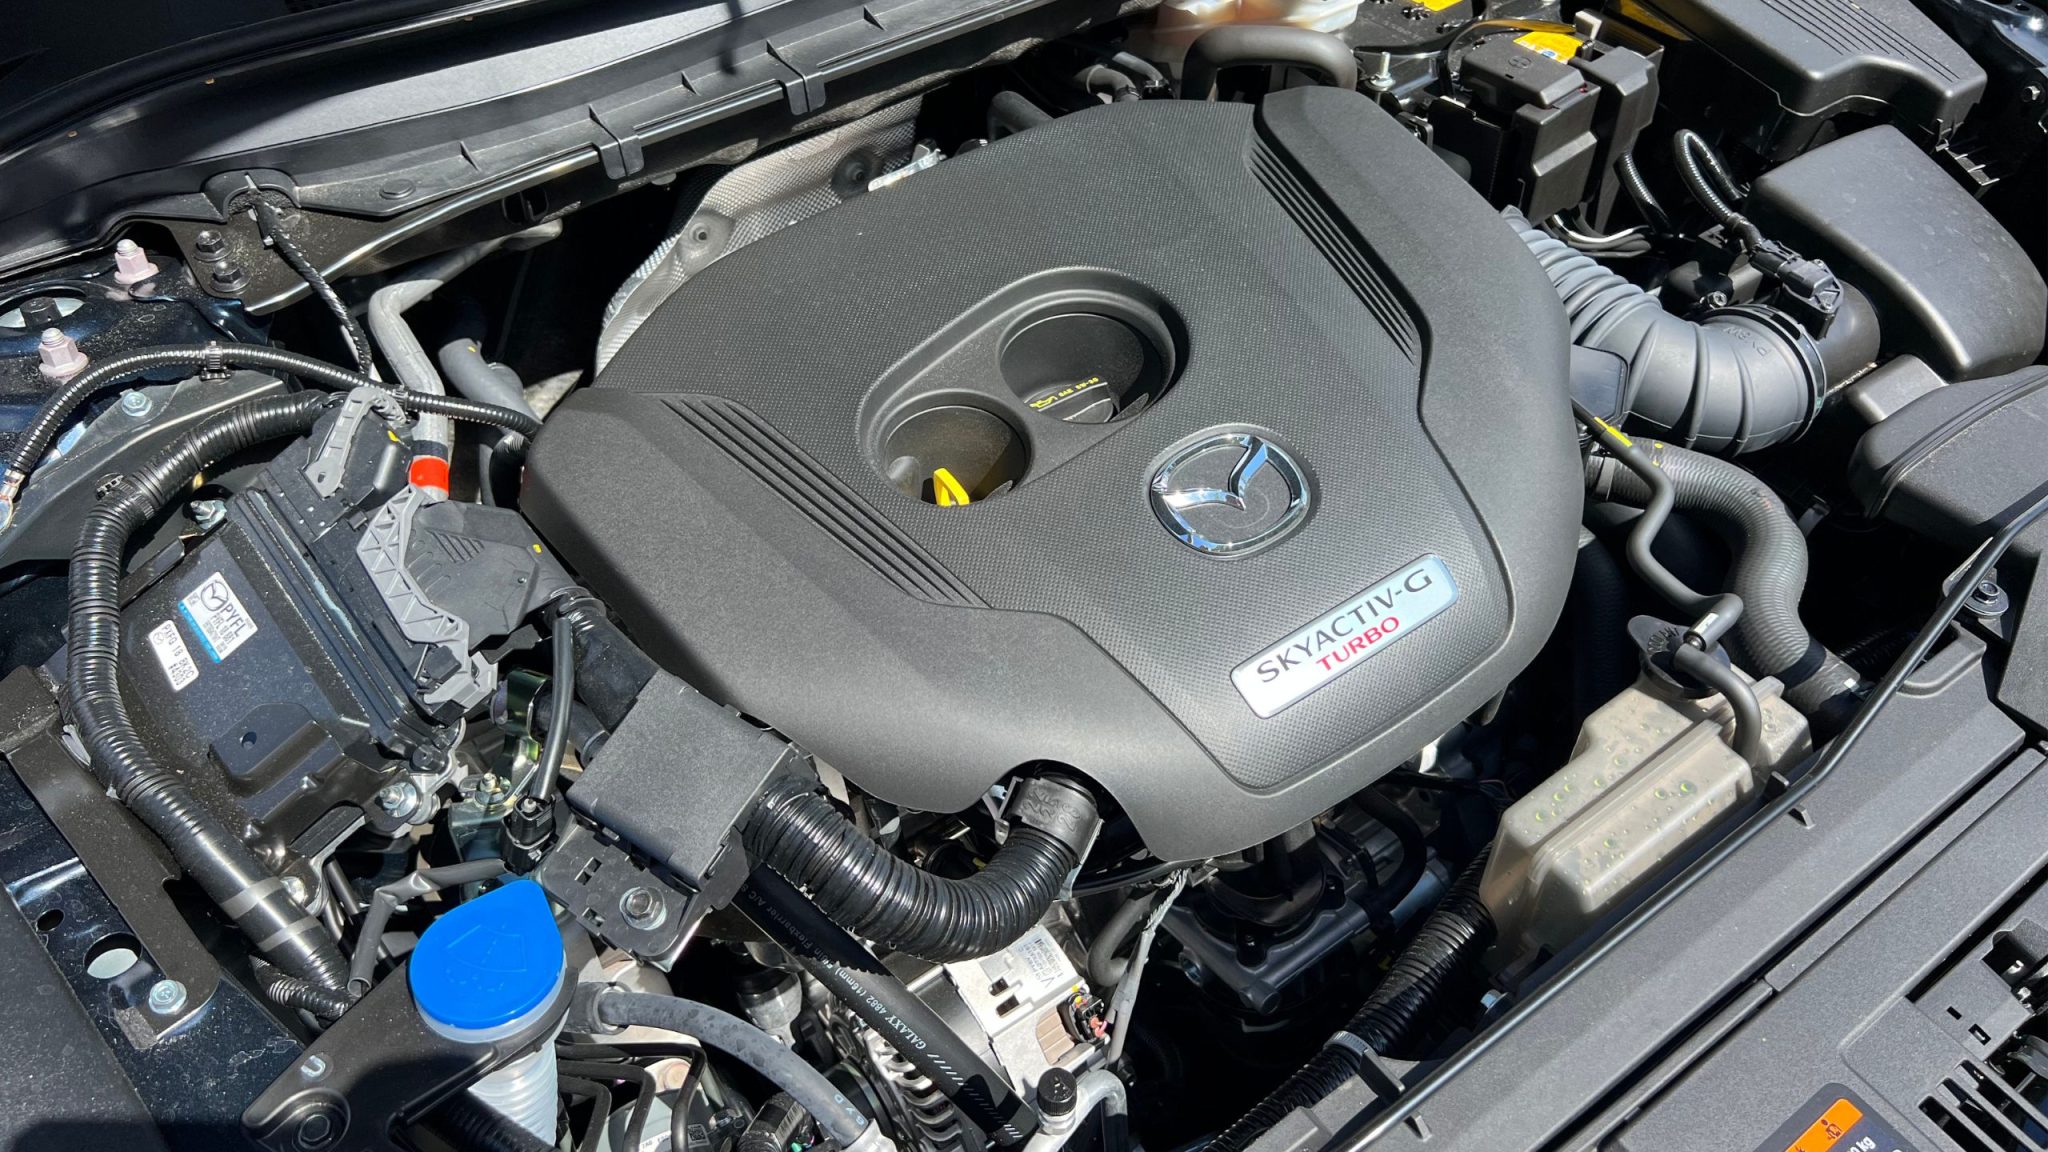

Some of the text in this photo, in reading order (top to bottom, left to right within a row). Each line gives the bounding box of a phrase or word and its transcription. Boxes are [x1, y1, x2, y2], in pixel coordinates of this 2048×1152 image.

[1058, 388, 1074, 397] SAE
[220, 603, 248, 638] PYFL
[1256, 568, 1433, 683] SKYACTIV-G
[1316, 616, 1400, 671] TURBO
[766, 906, 813, 949] Flexbarrier
[834, 966, 867, 997] (16mm)
[865, 995, 887, 1015] 4882
[884, 1015, 927, 1050] GALAXY
